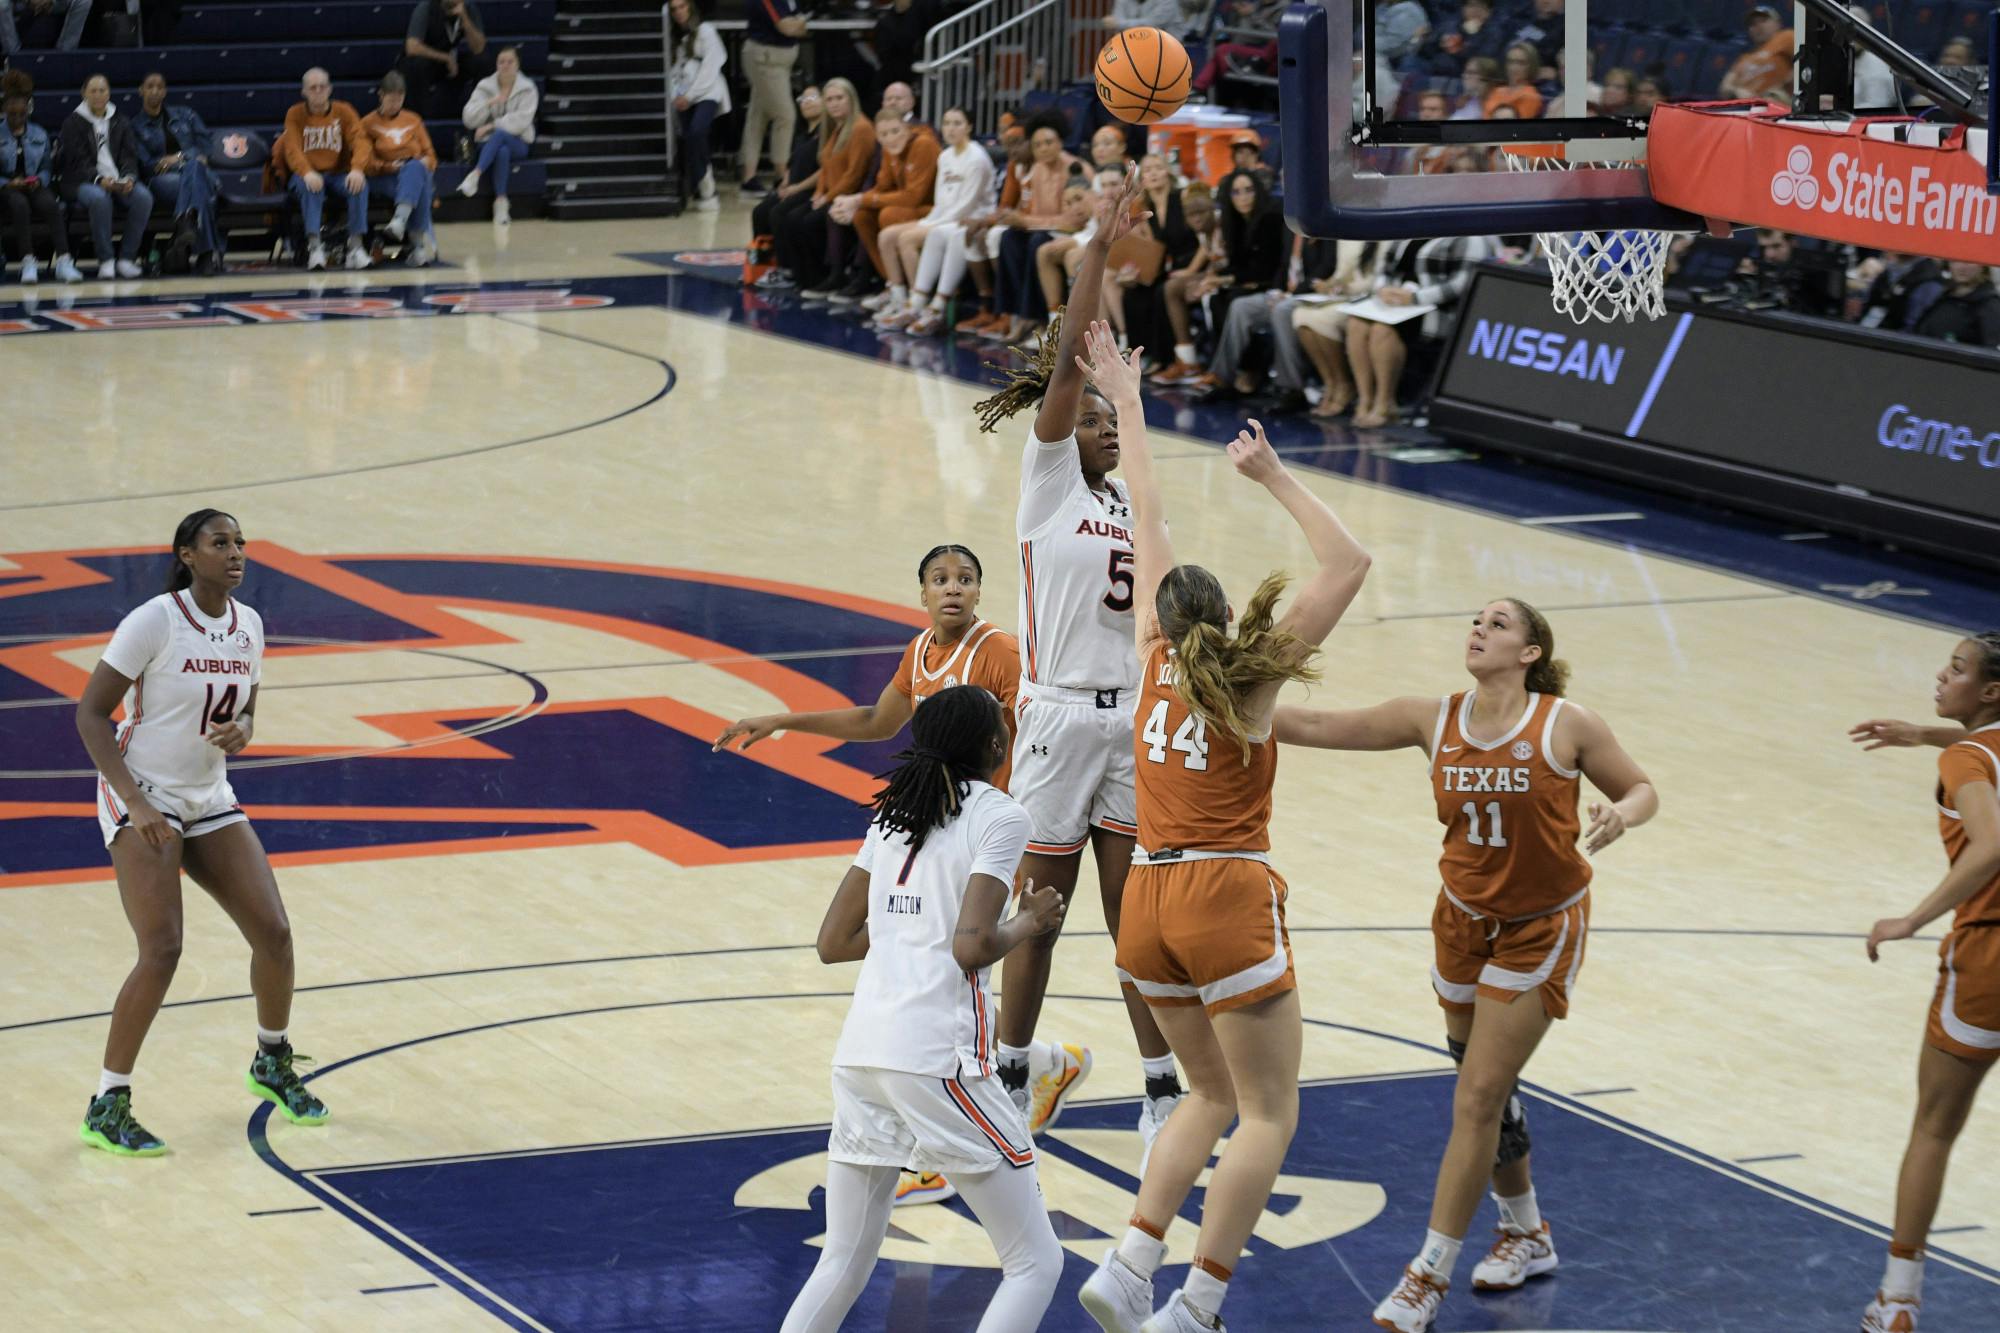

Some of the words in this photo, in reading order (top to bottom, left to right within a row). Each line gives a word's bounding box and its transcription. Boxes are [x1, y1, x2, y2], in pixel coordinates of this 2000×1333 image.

[1467, 318, 1627, 385] NISSAN
[1103, 549, 1134, 611] 5
[182, 659, 250, 675] AUBURN
[199, 683, 239, 736] 14
[1141, 699, 1209, 772] 44
[1441, 766, 1531, 793] TEXAS
[1461, 800, 1508, 848] 11
[887, 895, 922, 914] MILTON
